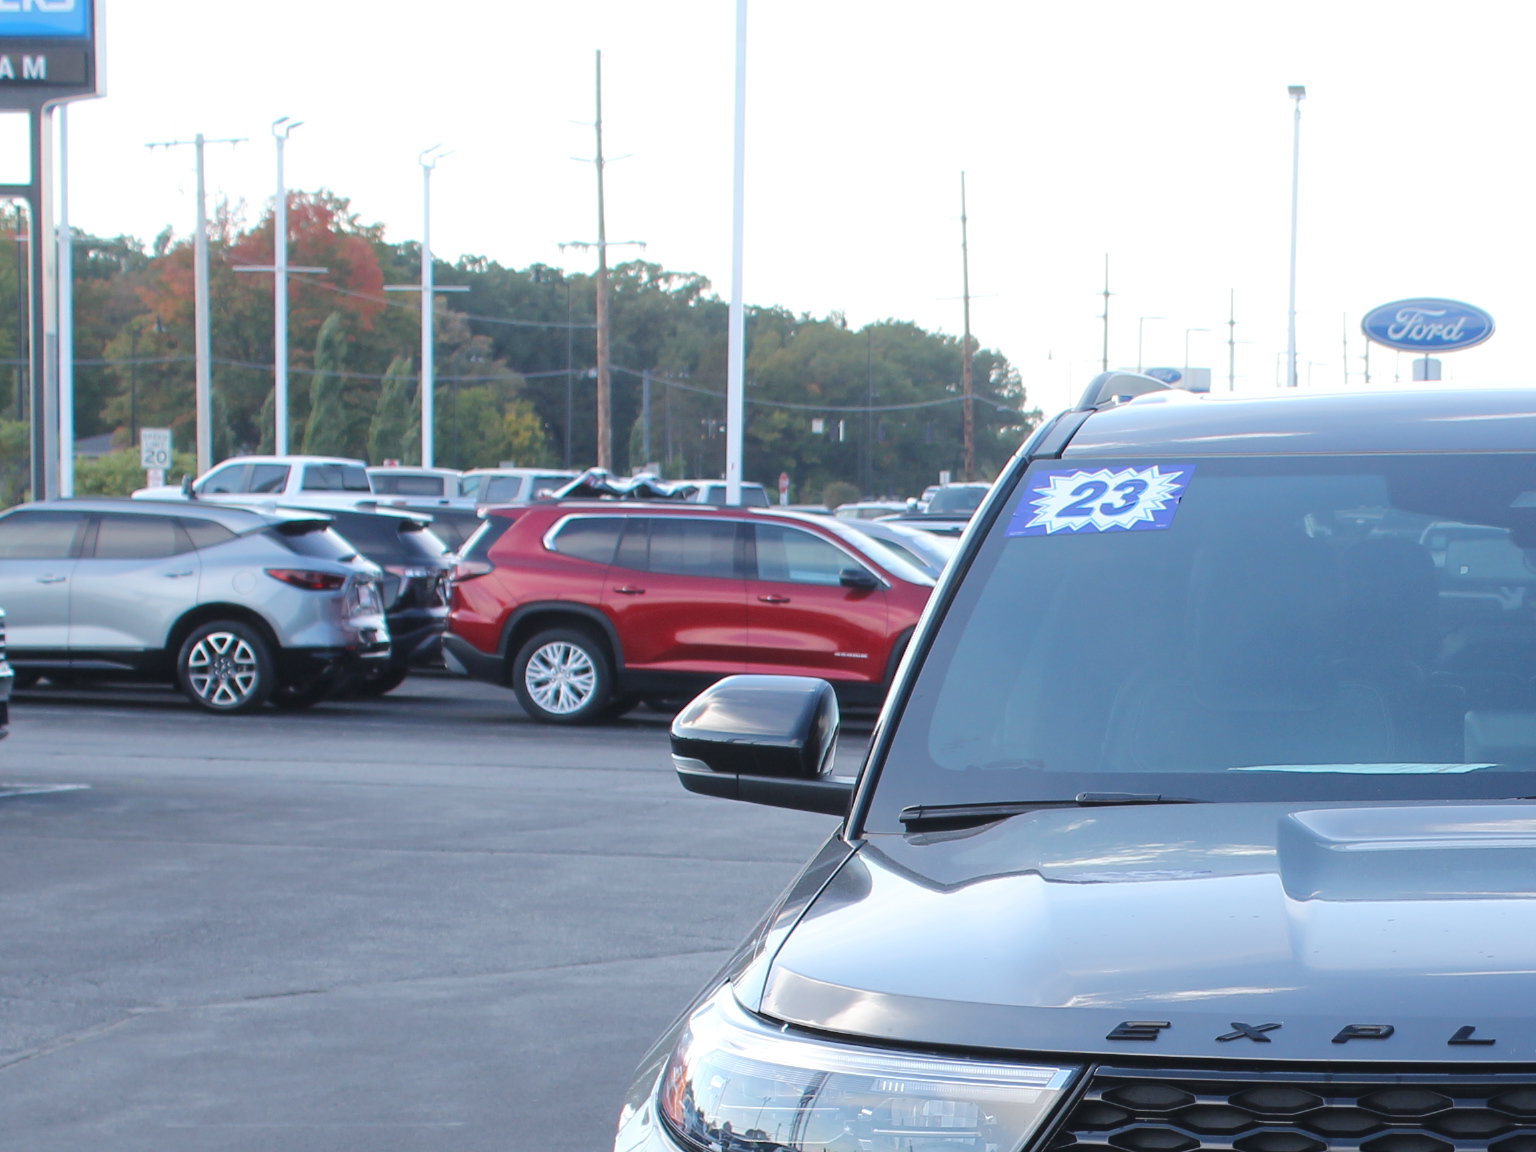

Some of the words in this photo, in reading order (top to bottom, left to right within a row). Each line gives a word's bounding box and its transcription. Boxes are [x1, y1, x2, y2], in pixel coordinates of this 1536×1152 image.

[1387, 307, 1466, 341] Ford
[144, 448, 168, 465] 20
[1055, 478, 1149, 518] 23
